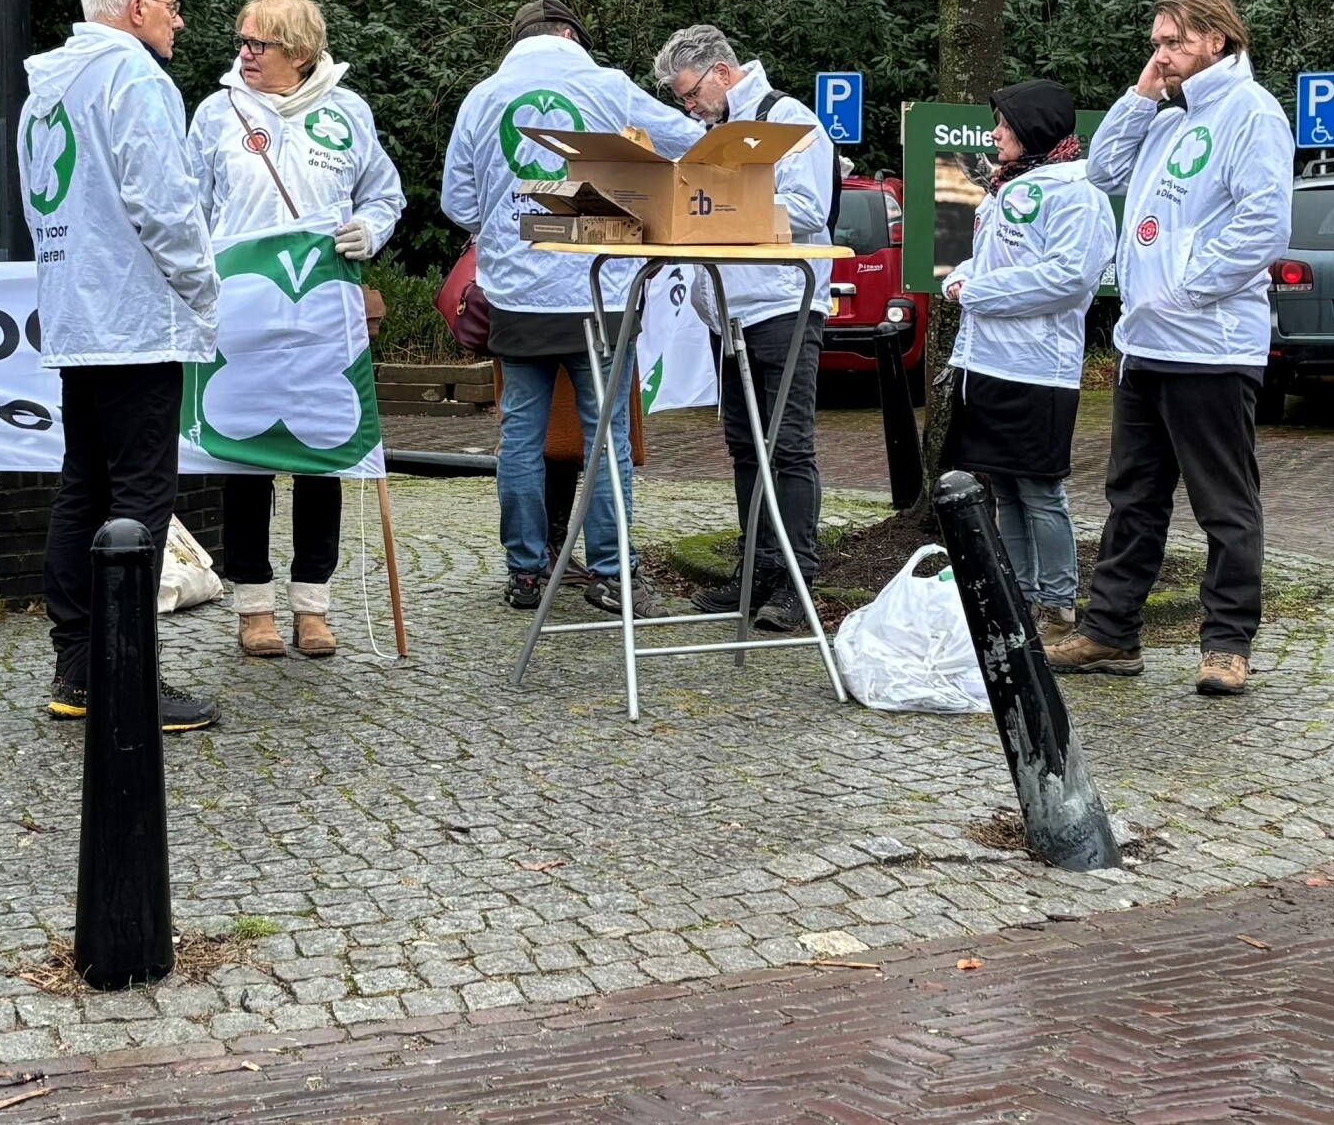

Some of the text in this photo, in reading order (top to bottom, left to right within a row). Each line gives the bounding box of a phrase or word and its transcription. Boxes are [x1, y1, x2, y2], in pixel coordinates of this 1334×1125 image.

[827, 79, 851, 114] P
[934, 124, 999, 147] Schie
[45, 225, 68, 238] voor
[38, 247, 65, 264] ieren
